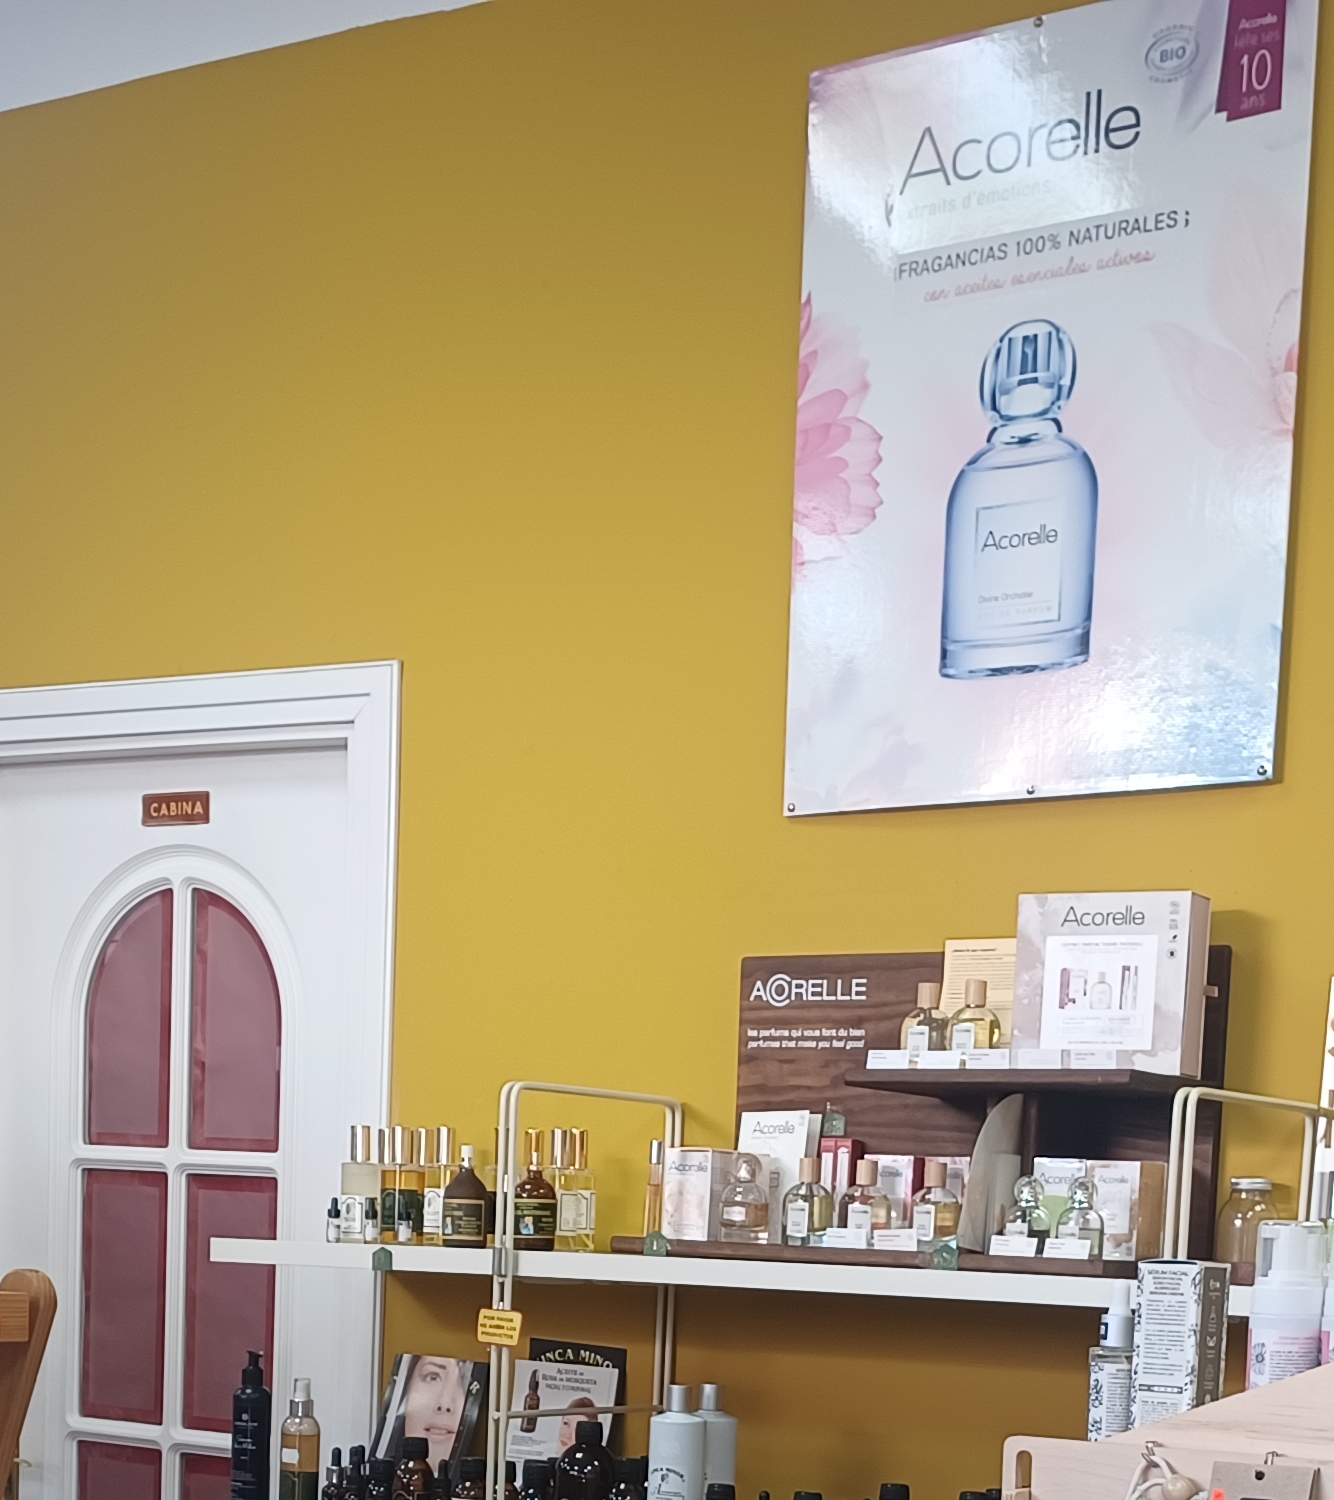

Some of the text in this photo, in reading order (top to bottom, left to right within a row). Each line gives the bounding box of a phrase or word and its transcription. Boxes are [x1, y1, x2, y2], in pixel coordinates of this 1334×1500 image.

[1159, 46, 1186, 63] BIO
[1240, 49, 1272, 93] 10
[899, 89, 1141, 195] Acorelle
[1016, 233, 1061, 258] 100%
[1067, 210, 1178, 247] NATURALES
[981, 523, 1058, 552] Acorelle
[150, 801, 204, 817] CABINA
[1060, 905, 1146, 927] Acorelle
[750, 974, 868, 1007] ACORELLE
[752, 1120, 796, 1136] Acorelle
